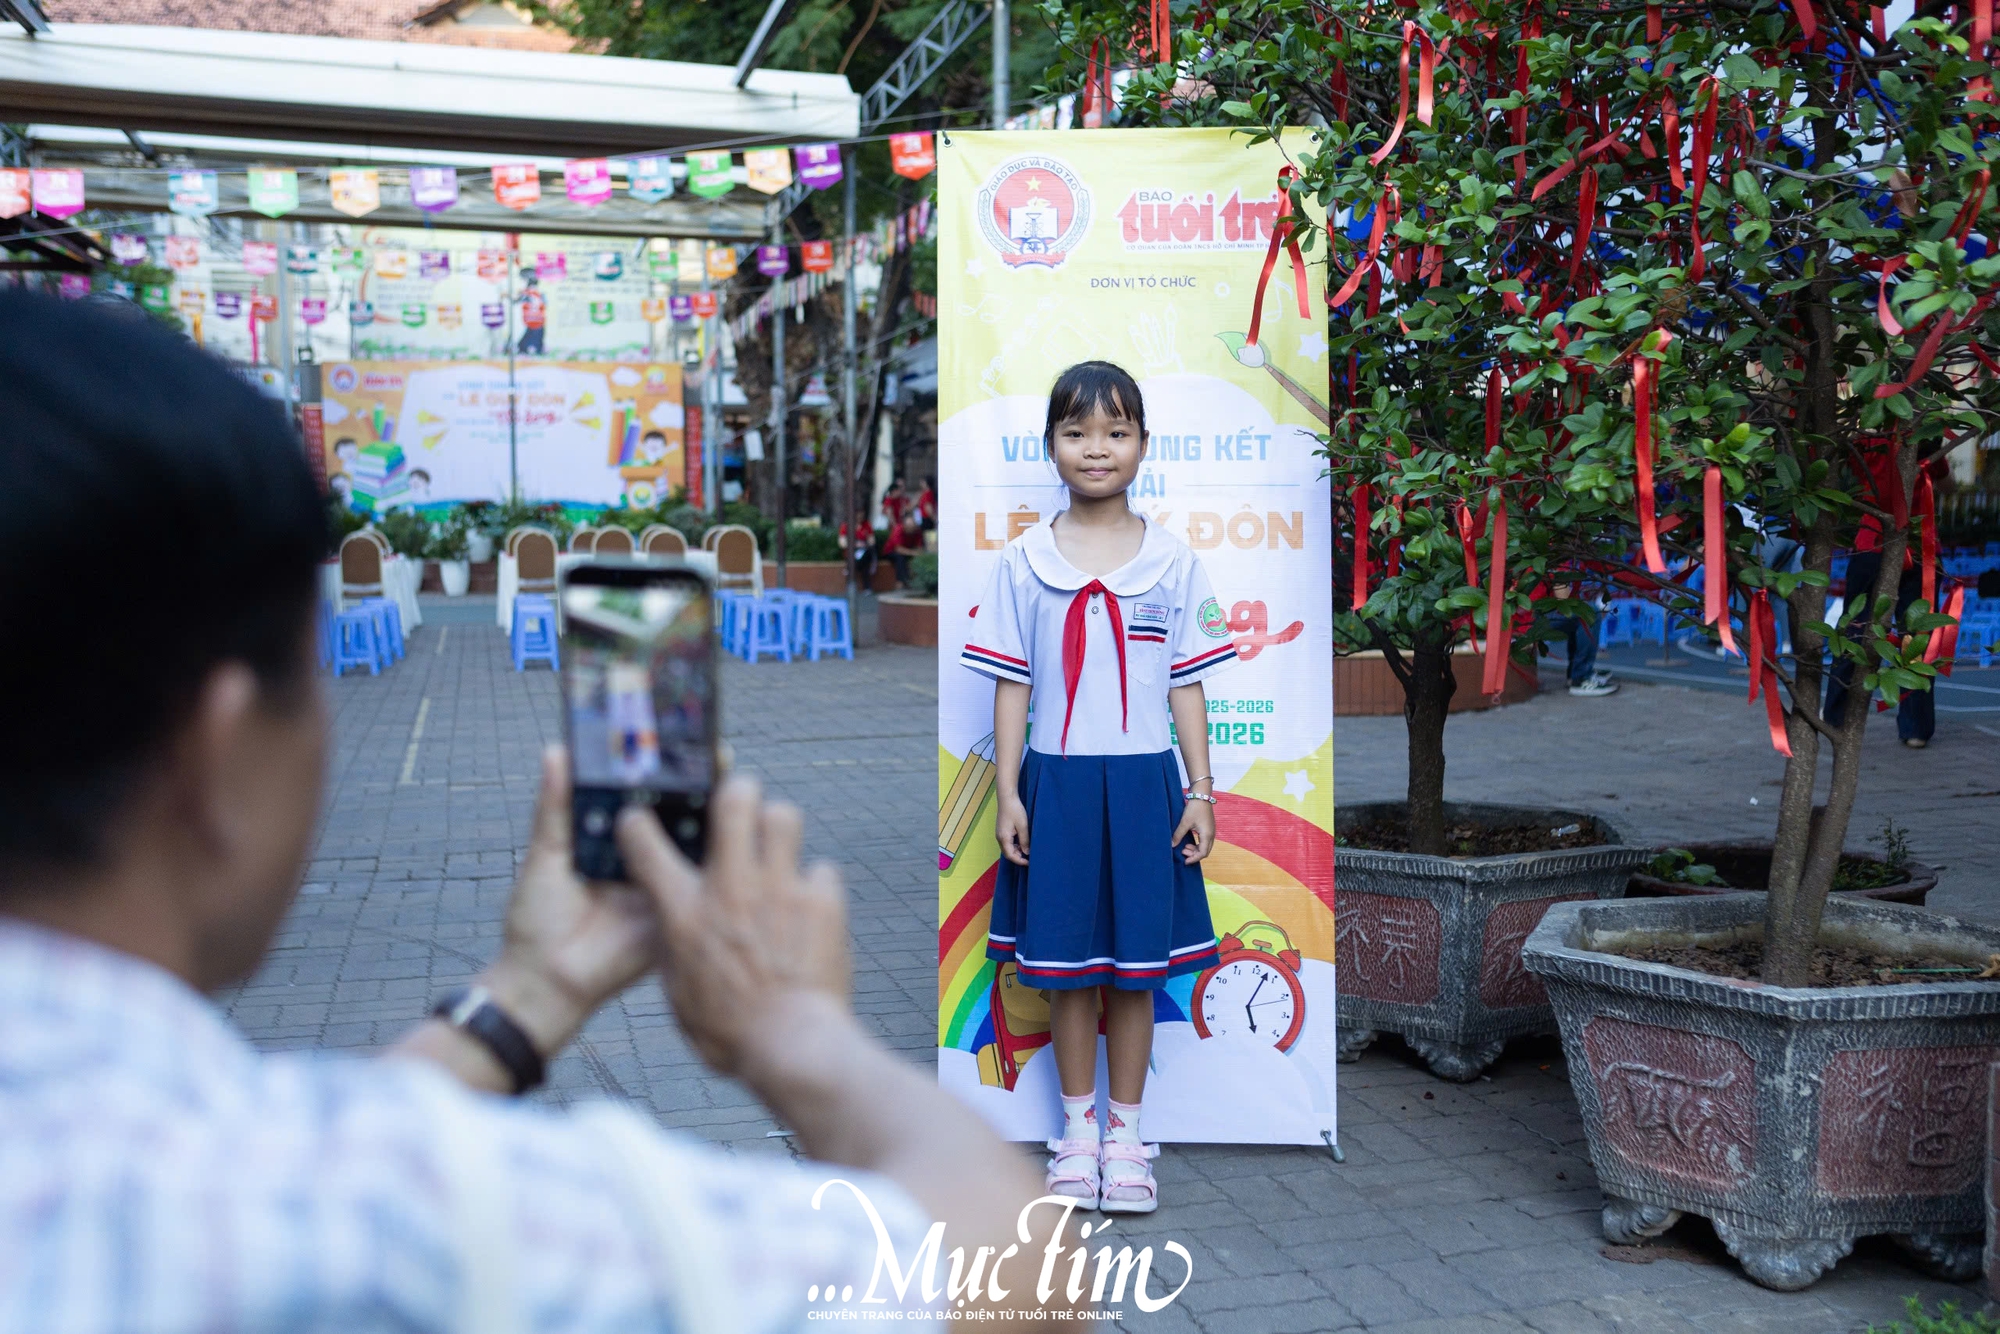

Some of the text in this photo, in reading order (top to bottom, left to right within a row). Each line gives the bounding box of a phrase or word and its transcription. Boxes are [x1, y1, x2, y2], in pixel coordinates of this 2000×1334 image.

[1007, 160, 1028, 174] DỤC
[1029, 157, 1041, 166] VÀ
[1090, 276, 1120, 288] ĐƠN
[1123, 277, 1134, 290] VỊ
[1160, 275, 1197, 288] CHỨC
[1214, 427, 1272, 461] KẾT
[1185, 503, 1304, 550] ĐÔN
[1252, 967, 1261, 976] 12
[1218, 977, 1228, 985] 10
